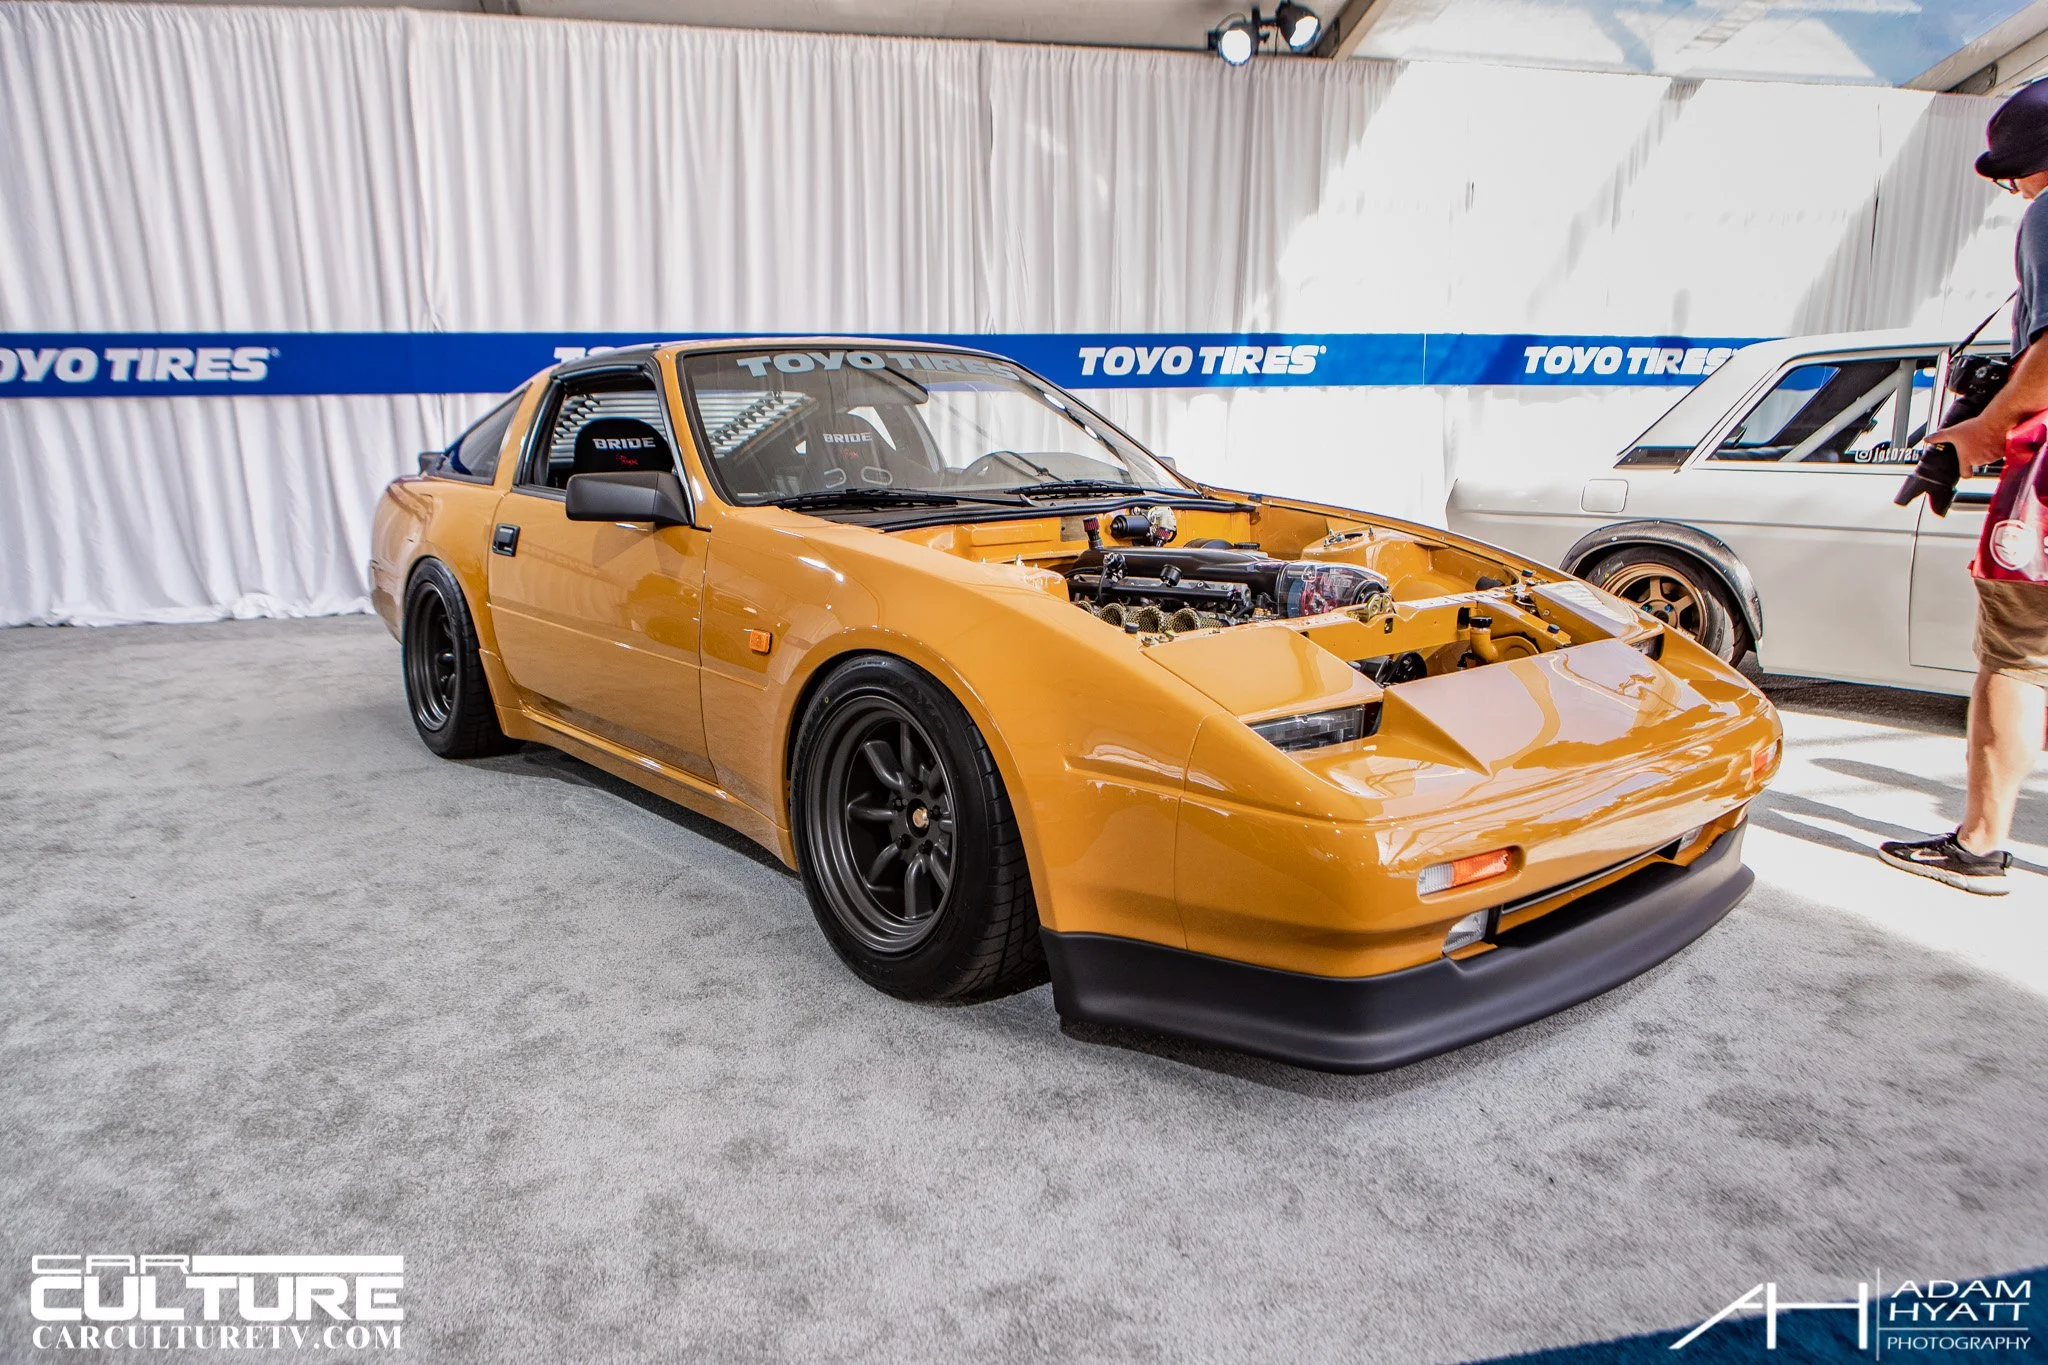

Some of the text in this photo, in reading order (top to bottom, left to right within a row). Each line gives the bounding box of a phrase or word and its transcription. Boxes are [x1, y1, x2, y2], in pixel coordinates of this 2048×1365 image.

[104, 346, 270, 382] TIRES
[737, 351, 1020, 381] TOYO TIRES
[1078, 345, 1320, 376] TOYO TIRES
[1523, 346, 1623, 375] TOYO
[592, 437, 656, 450] BRIDE
[823, 432, 873, 444] BRIDE
